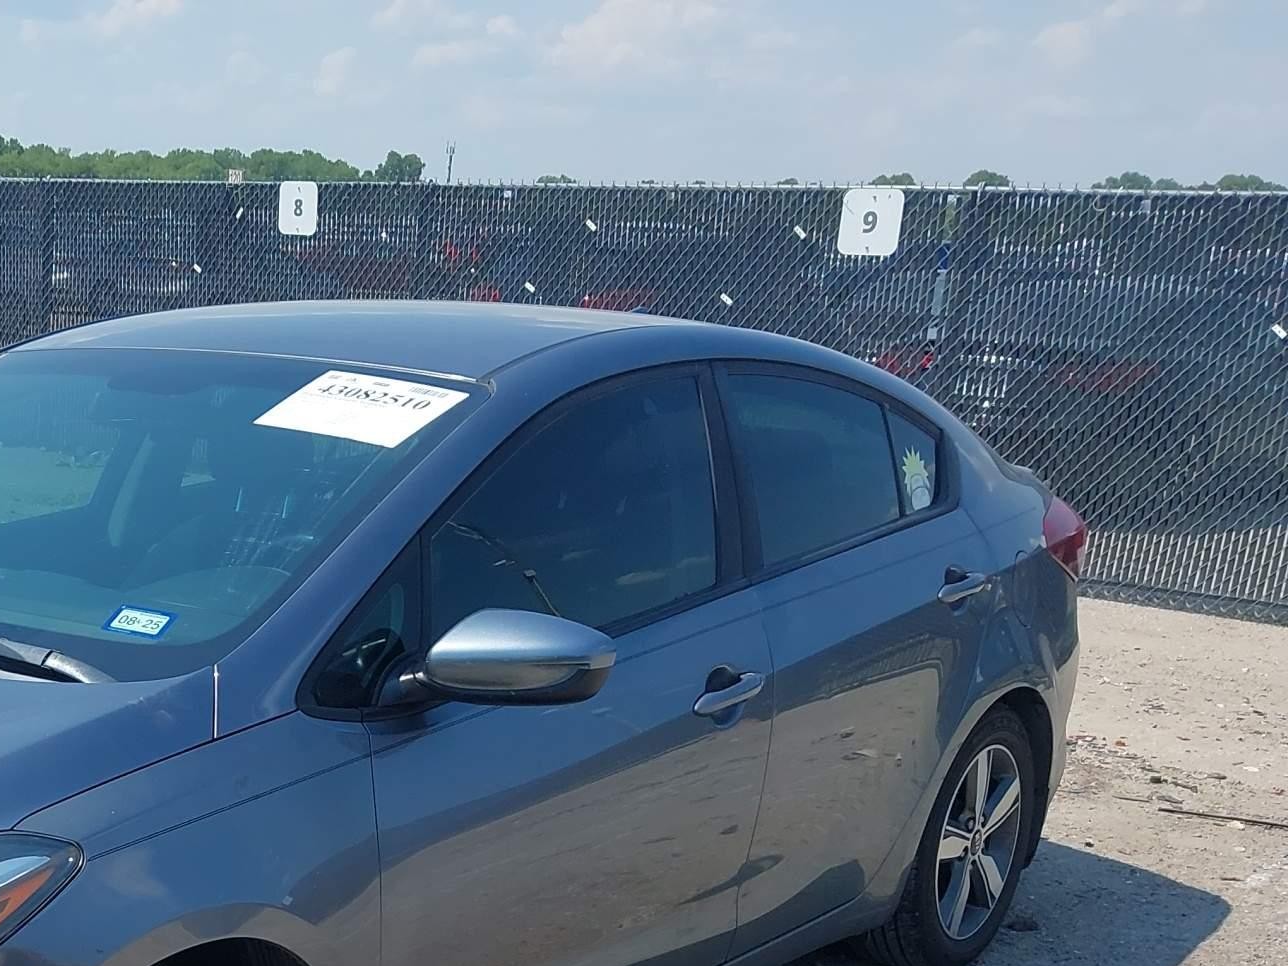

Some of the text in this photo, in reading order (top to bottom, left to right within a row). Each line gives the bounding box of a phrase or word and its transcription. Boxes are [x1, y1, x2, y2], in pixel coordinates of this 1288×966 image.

[293, 198, 303, 217] 8
[862, 210, 878, 233] 9
[317, 384, 431, 410] 43082510
[117, 614, 138, 626] 08
[142, 619, 163, 630] 25
